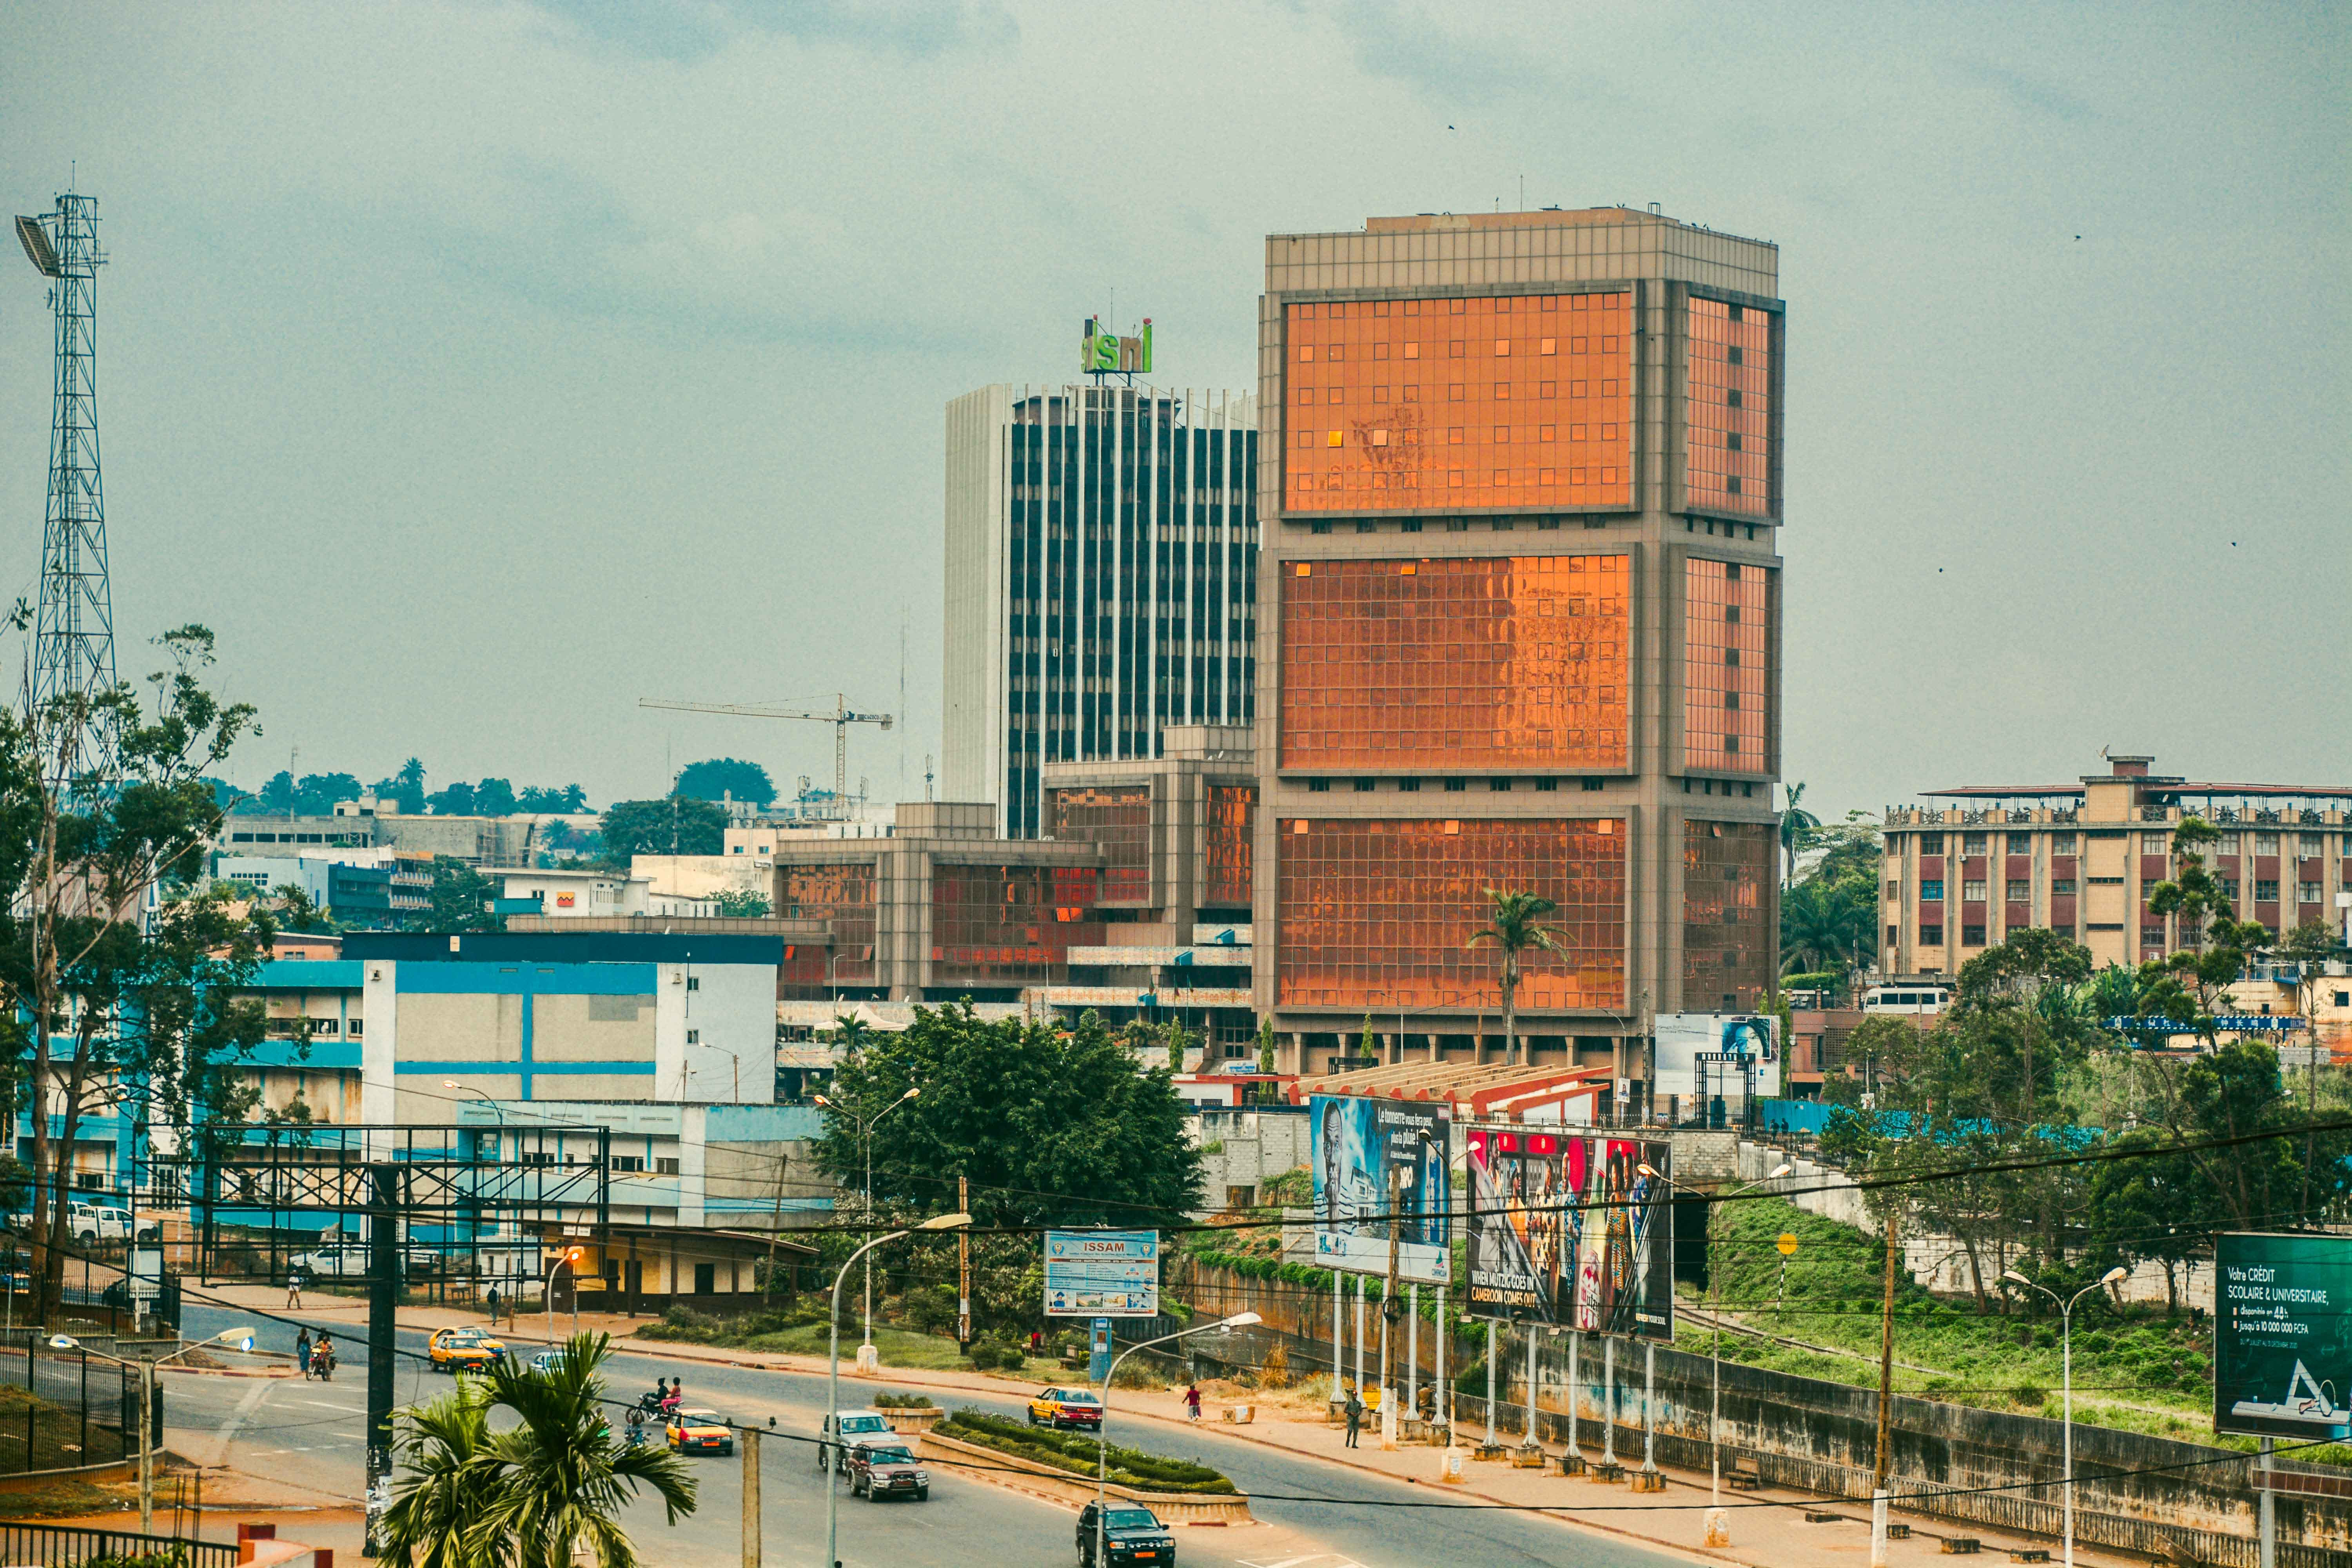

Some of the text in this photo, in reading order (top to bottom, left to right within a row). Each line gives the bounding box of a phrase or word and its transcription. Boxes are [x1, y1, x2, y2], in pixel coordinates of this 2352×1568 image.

[1378, 1107, 1384, 1123] Le
[1385, 1108, 1405, 1125] tonnerre
[1405, 1116, 1415, 1126] vous
[1415, 1113, 1423, 1126] fera
[1403, 1129, 1416, 1148] pluie
[1084, 1242, 1124, 1252] ISSAM
[1472, 1270, 1534, 1291] WHEN MUTZIG GOES IN
[2228, 1265, 2275, 1282] Votre CRÉDIT
[1472, 1286, 1537, 1308] CAMEROON COMES OUT
[2228, 1285, 2329, 1306] SCOLAIRE & UNIVERSITAIRE,
[2240, 1304, 2265, 1317] disponible
[2239, 1320, 2308, 1334] jusqu'à 10 000 000 FCFA
